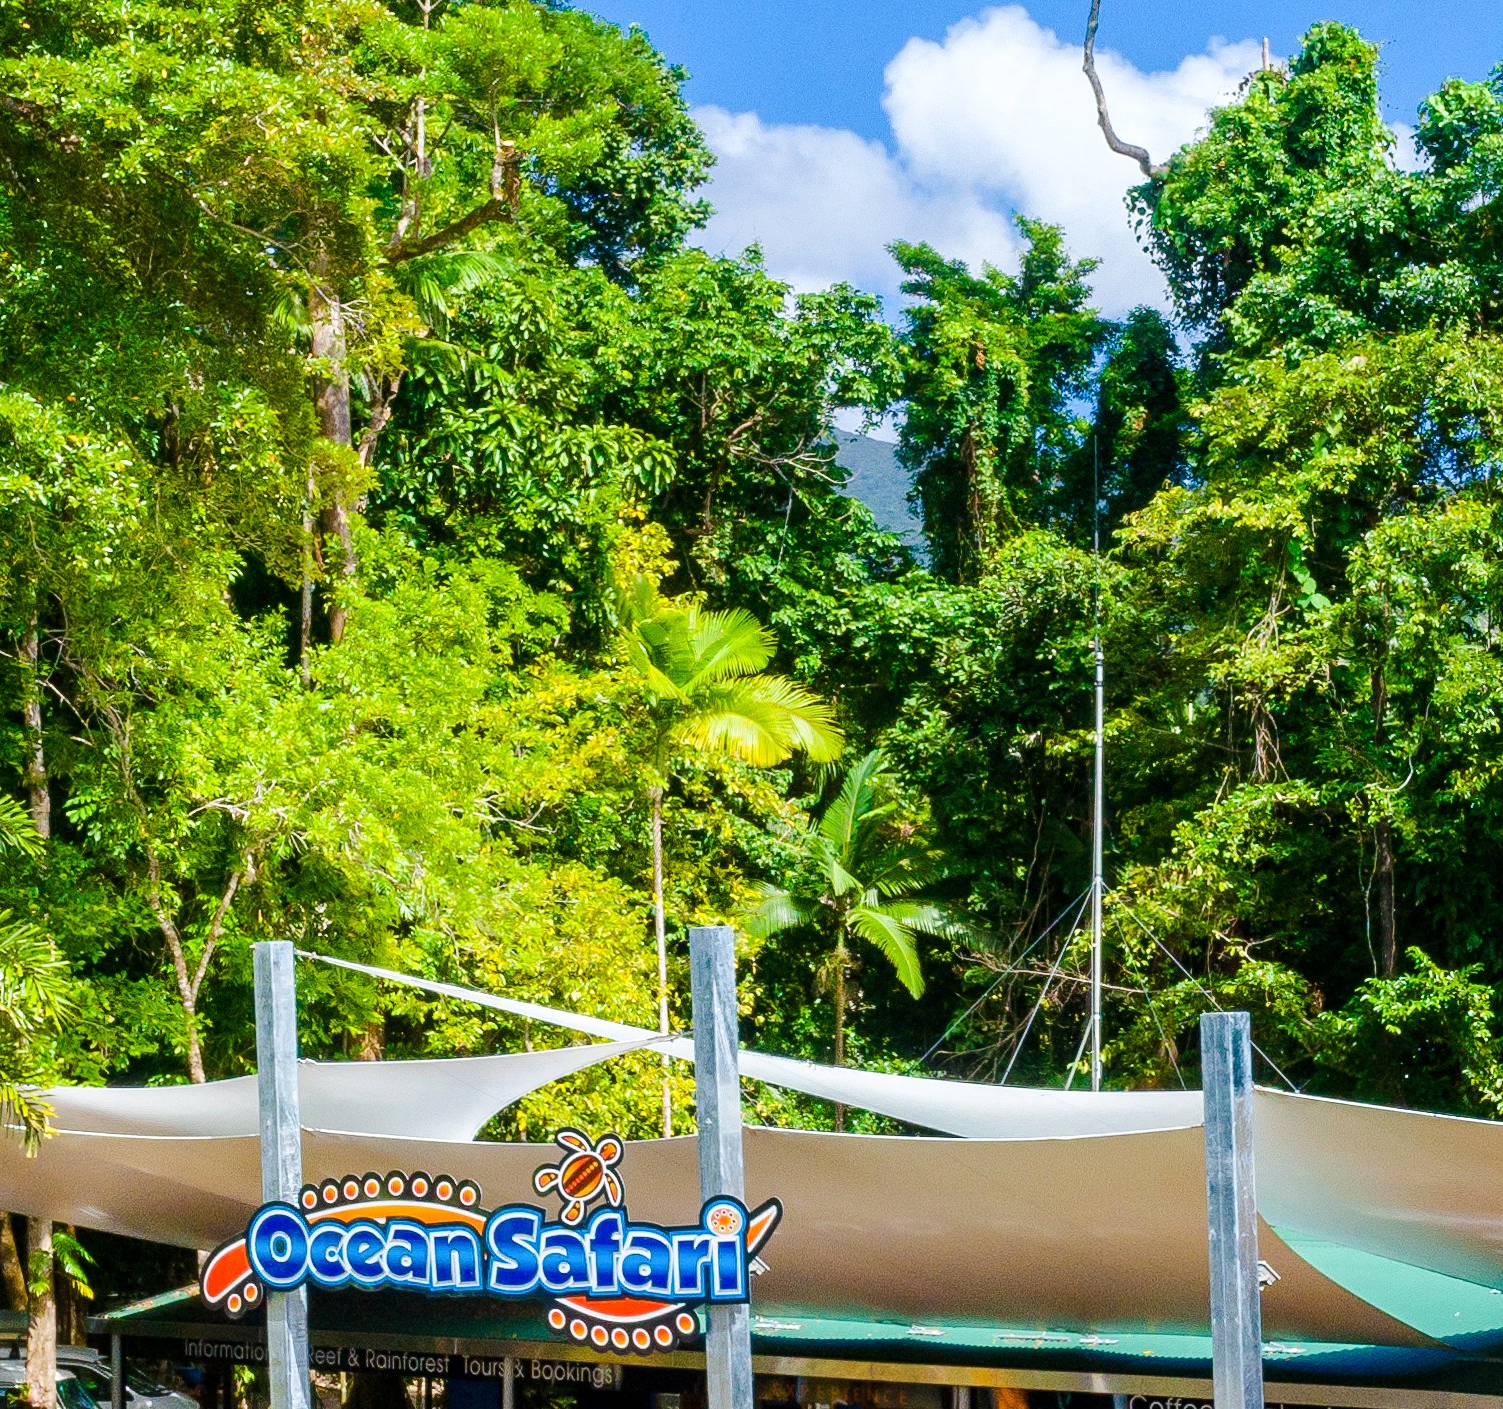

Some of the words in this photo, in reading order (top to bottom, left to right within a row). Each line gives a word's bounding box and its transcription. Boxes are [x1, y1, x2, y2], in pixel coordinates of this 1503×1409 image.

[251, 1206, 482, 1292] Ocean
[487, 1199, 749, 1299] Safari
[185, 1339, 268, 1362] Informatio
[348, 1347, 361, 1368] &
[366, 1348, 450, 1374] Rainforest
[463, 1354, 505, 1377] Tours
[531, 1360, 613, 1388] Bookings
